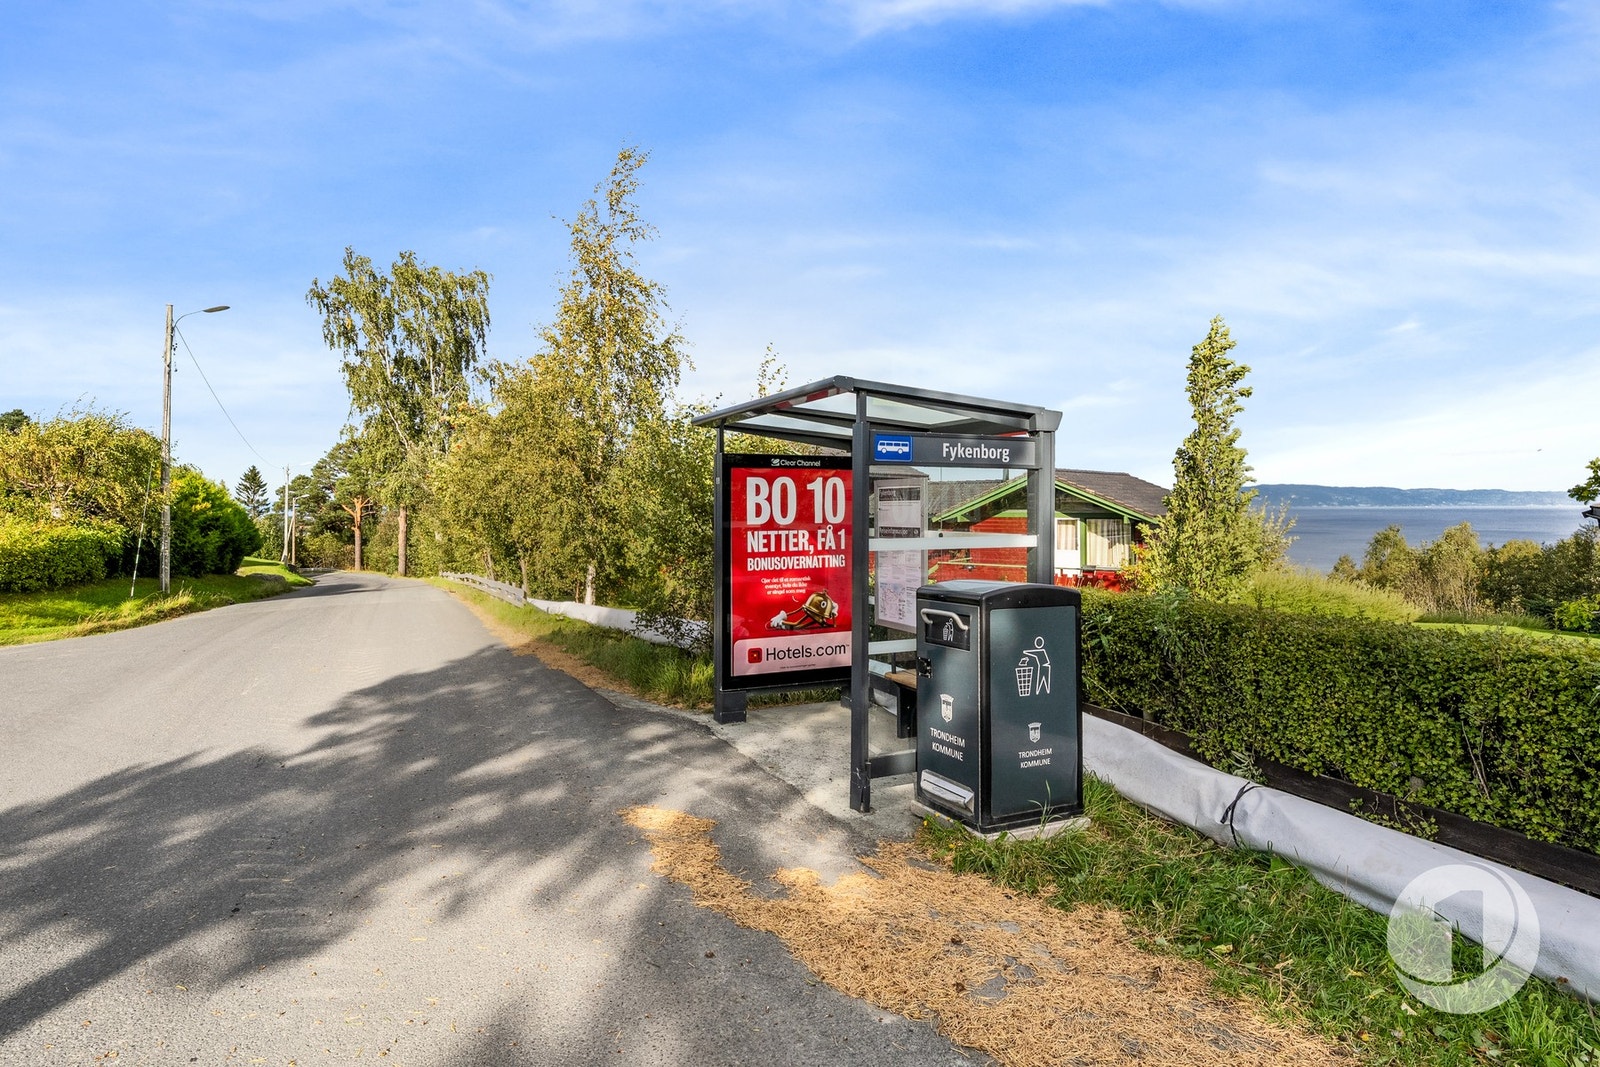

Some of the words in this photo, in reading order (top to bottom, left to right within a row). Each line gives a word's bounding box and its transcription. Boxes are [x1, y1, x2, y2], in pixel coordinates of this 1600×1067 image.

[942, 442, 1010, 462] Fykenborg
[796, 459, 821, 467] Channel
[746, 476, 797, 525] BO
[807, 476, 846, 525] 10
[746, 530, 814, 554] NETTER,
[817, 525, 836, 550] FÅ
[839, 528, 846, 550] 1
[747, 555, 846, 572] BONUSOVERNATTING
[766, 644, 846, 661] Hotels.com
[930, 727, 966, 748] TRONDHEIM
[932, 742, 964, 762] KOMMUNE
[1018, 748, 1052, 759] TRONDHEIM
[1020, 757, 1051, 768] KOMMUNE
